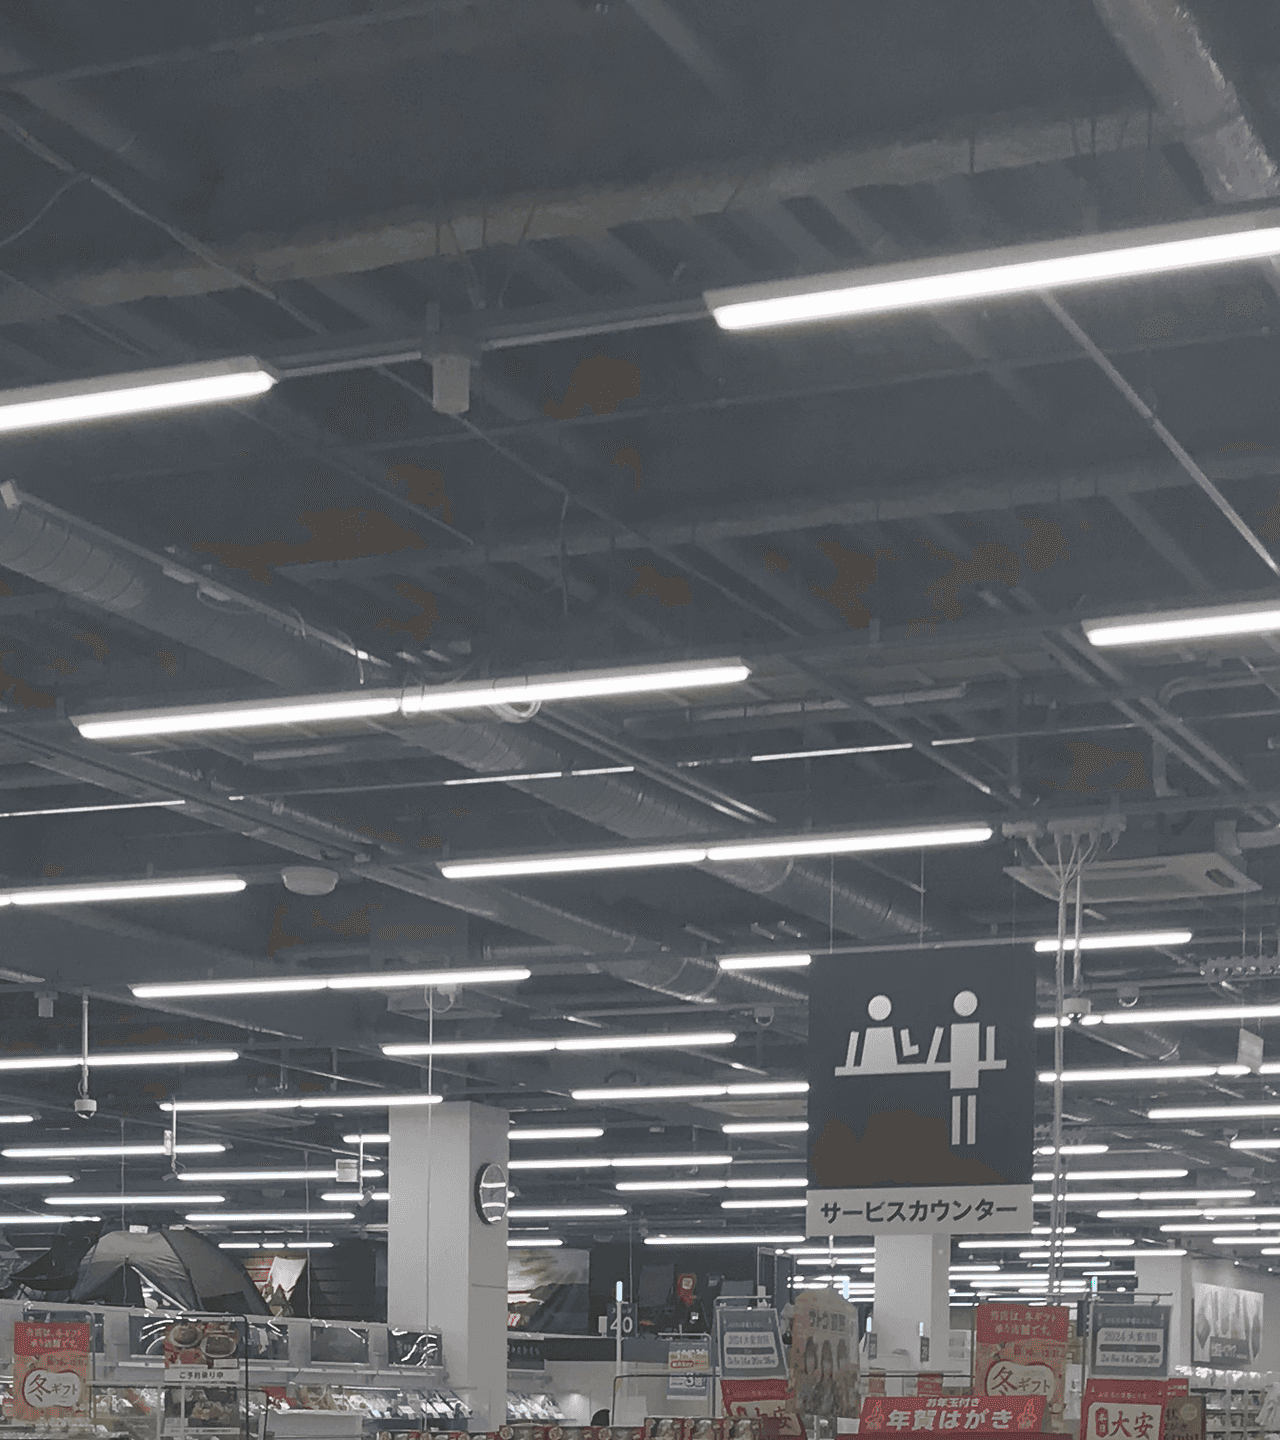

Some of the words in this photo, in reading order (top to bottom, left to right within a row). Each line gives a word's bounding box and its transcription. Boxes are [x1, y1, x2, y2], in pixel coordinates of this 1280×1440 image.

[821, 1199, 1018, 1223] サービスカウンター
[887, 1408, 1013, 1431] 年賀はがき
[1108, 1410, 1154, 1440] 大安
